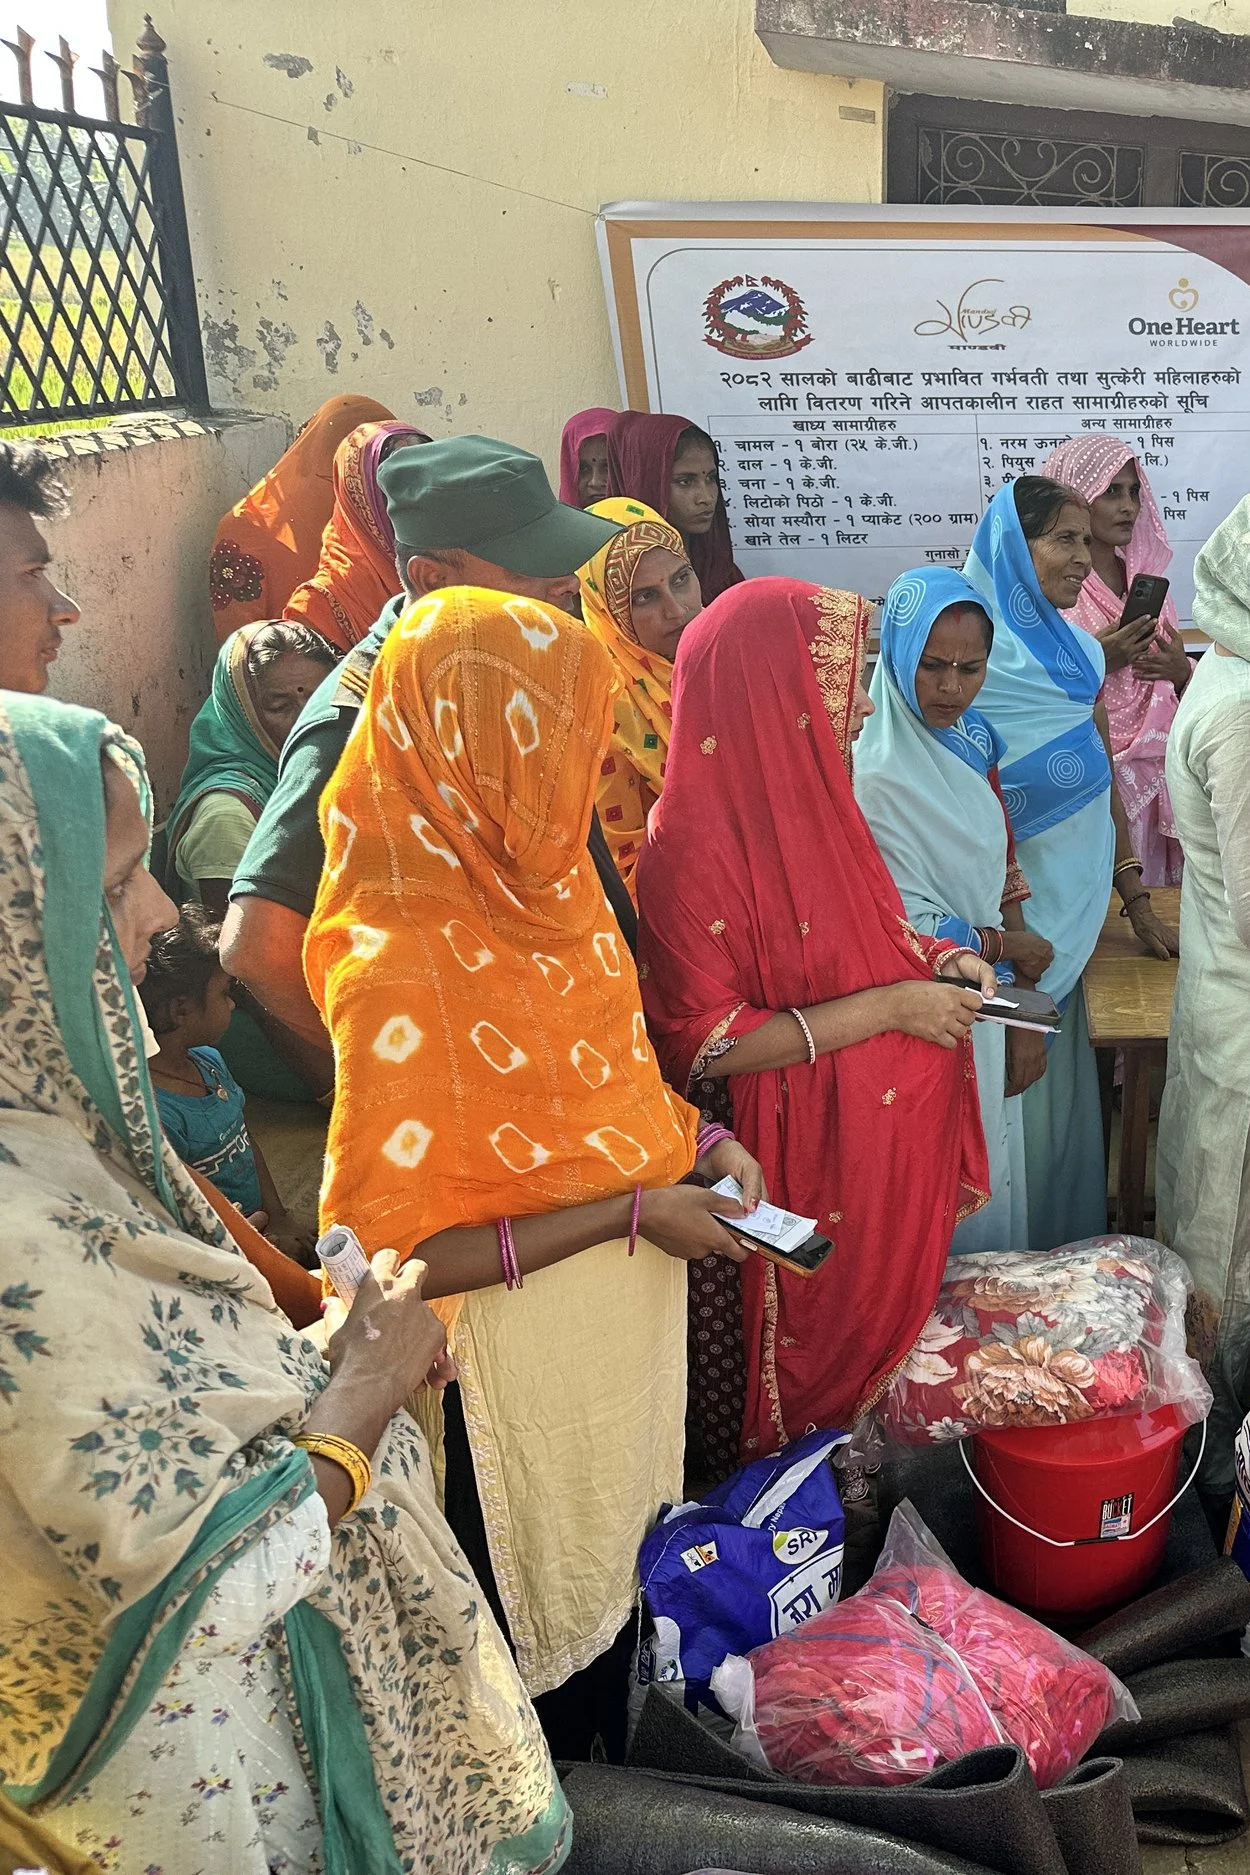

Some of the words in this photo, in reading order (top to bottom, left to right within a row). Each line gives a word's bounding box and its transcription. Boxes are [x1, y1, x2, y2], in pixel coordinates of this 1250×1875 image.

[1128, 317, 1172, 336] One
[1175, 317, 1240, 335] Heart
[1149, 339, 1219, 347] WORLDWIDE
[720, 371, 771, 388] २०८२
[780, 368, 837, 386] सालको
[846, 368, 913, 387] बाढीबाट
[921, 367, 982, 386] प्रभावित
[991, 367, 1048, 386] गर्भवती
[1056, 371, 1088, 386] तथा
[1096, 367, 1146, 390] सुत्केरी
[1154, 367, 1241, 385] महिलाहरुको
[758, 393, 798, 411] लागि
[806, 392, 862, 411] वितरण
[871, 392, 912, 411] गरिने
[921, 391, 1018, 410] आपतकालीन
[1026, 395, 1064, 410] राहत
[1072, 391, 1169, 410] सामाग्रीहरुको
[1176, 391, 1209, 413] सूचि
[832, 416, 897, 432] सामाग्रीहरु
[1081, 418, 1106, 429] अन्य
[1113, 415, 1172, 430] सामाग्रीहरु
[734, 440, 774, 452] चामल
[795, 439, 803, 452] १
[810, 436, 838, 451] बोरा
[845, 438, 868, 451] (२५
[874, 436, 918, 451] के.जी.)
[980, 438, 992, 451] १.
[1000, 438, 1028, 449] नरम
[1137, 436, 1145, 449] १
[1152, 433, 1175, 448] पिस
[737, 460, 763, 471] दाल
[783, 458, 792, 472] १
[800, 456, 837, 470] के.जी.
[982, 457, 994, 469] २.
[1001, 453, 1035, 472] पियुस
[738, 479, 766, 490] चना
[786, 477, 795, 491] १
[802, 475, 840, 489] के.जी.
[984, 475, 995, 487] ३.
[744, 494, 790, 509] लिटोको
[797, 493, 824, 509] पिठो
[844, 496, 853, 509] १
[860, 493, 896, 507] के.जी.
[1172, 491, 1180, 503] १
[1187, 488, 1210, 502] पिस
[744, 513, 775, 527] सोया
[782, 512, 827, 527] मस्यौरा
[846, 515, 855, 527] १
[862, 512, 902, 526] प्याकेट
[908, 513, 942, 526] (२००
[949, 511, 979, 526] ग्राम)
[1164, 506, 1187, 520] पिस
[744, 531, 772, 546] खाने
[779, 531, 801, 545] तेल
[821, 533, 829, 546] १
[836, 530, 868, 545] लिटर
[925, 547, 960, 562] गुनासो
[1102, 1496, 1132, 1520] BUCKET
